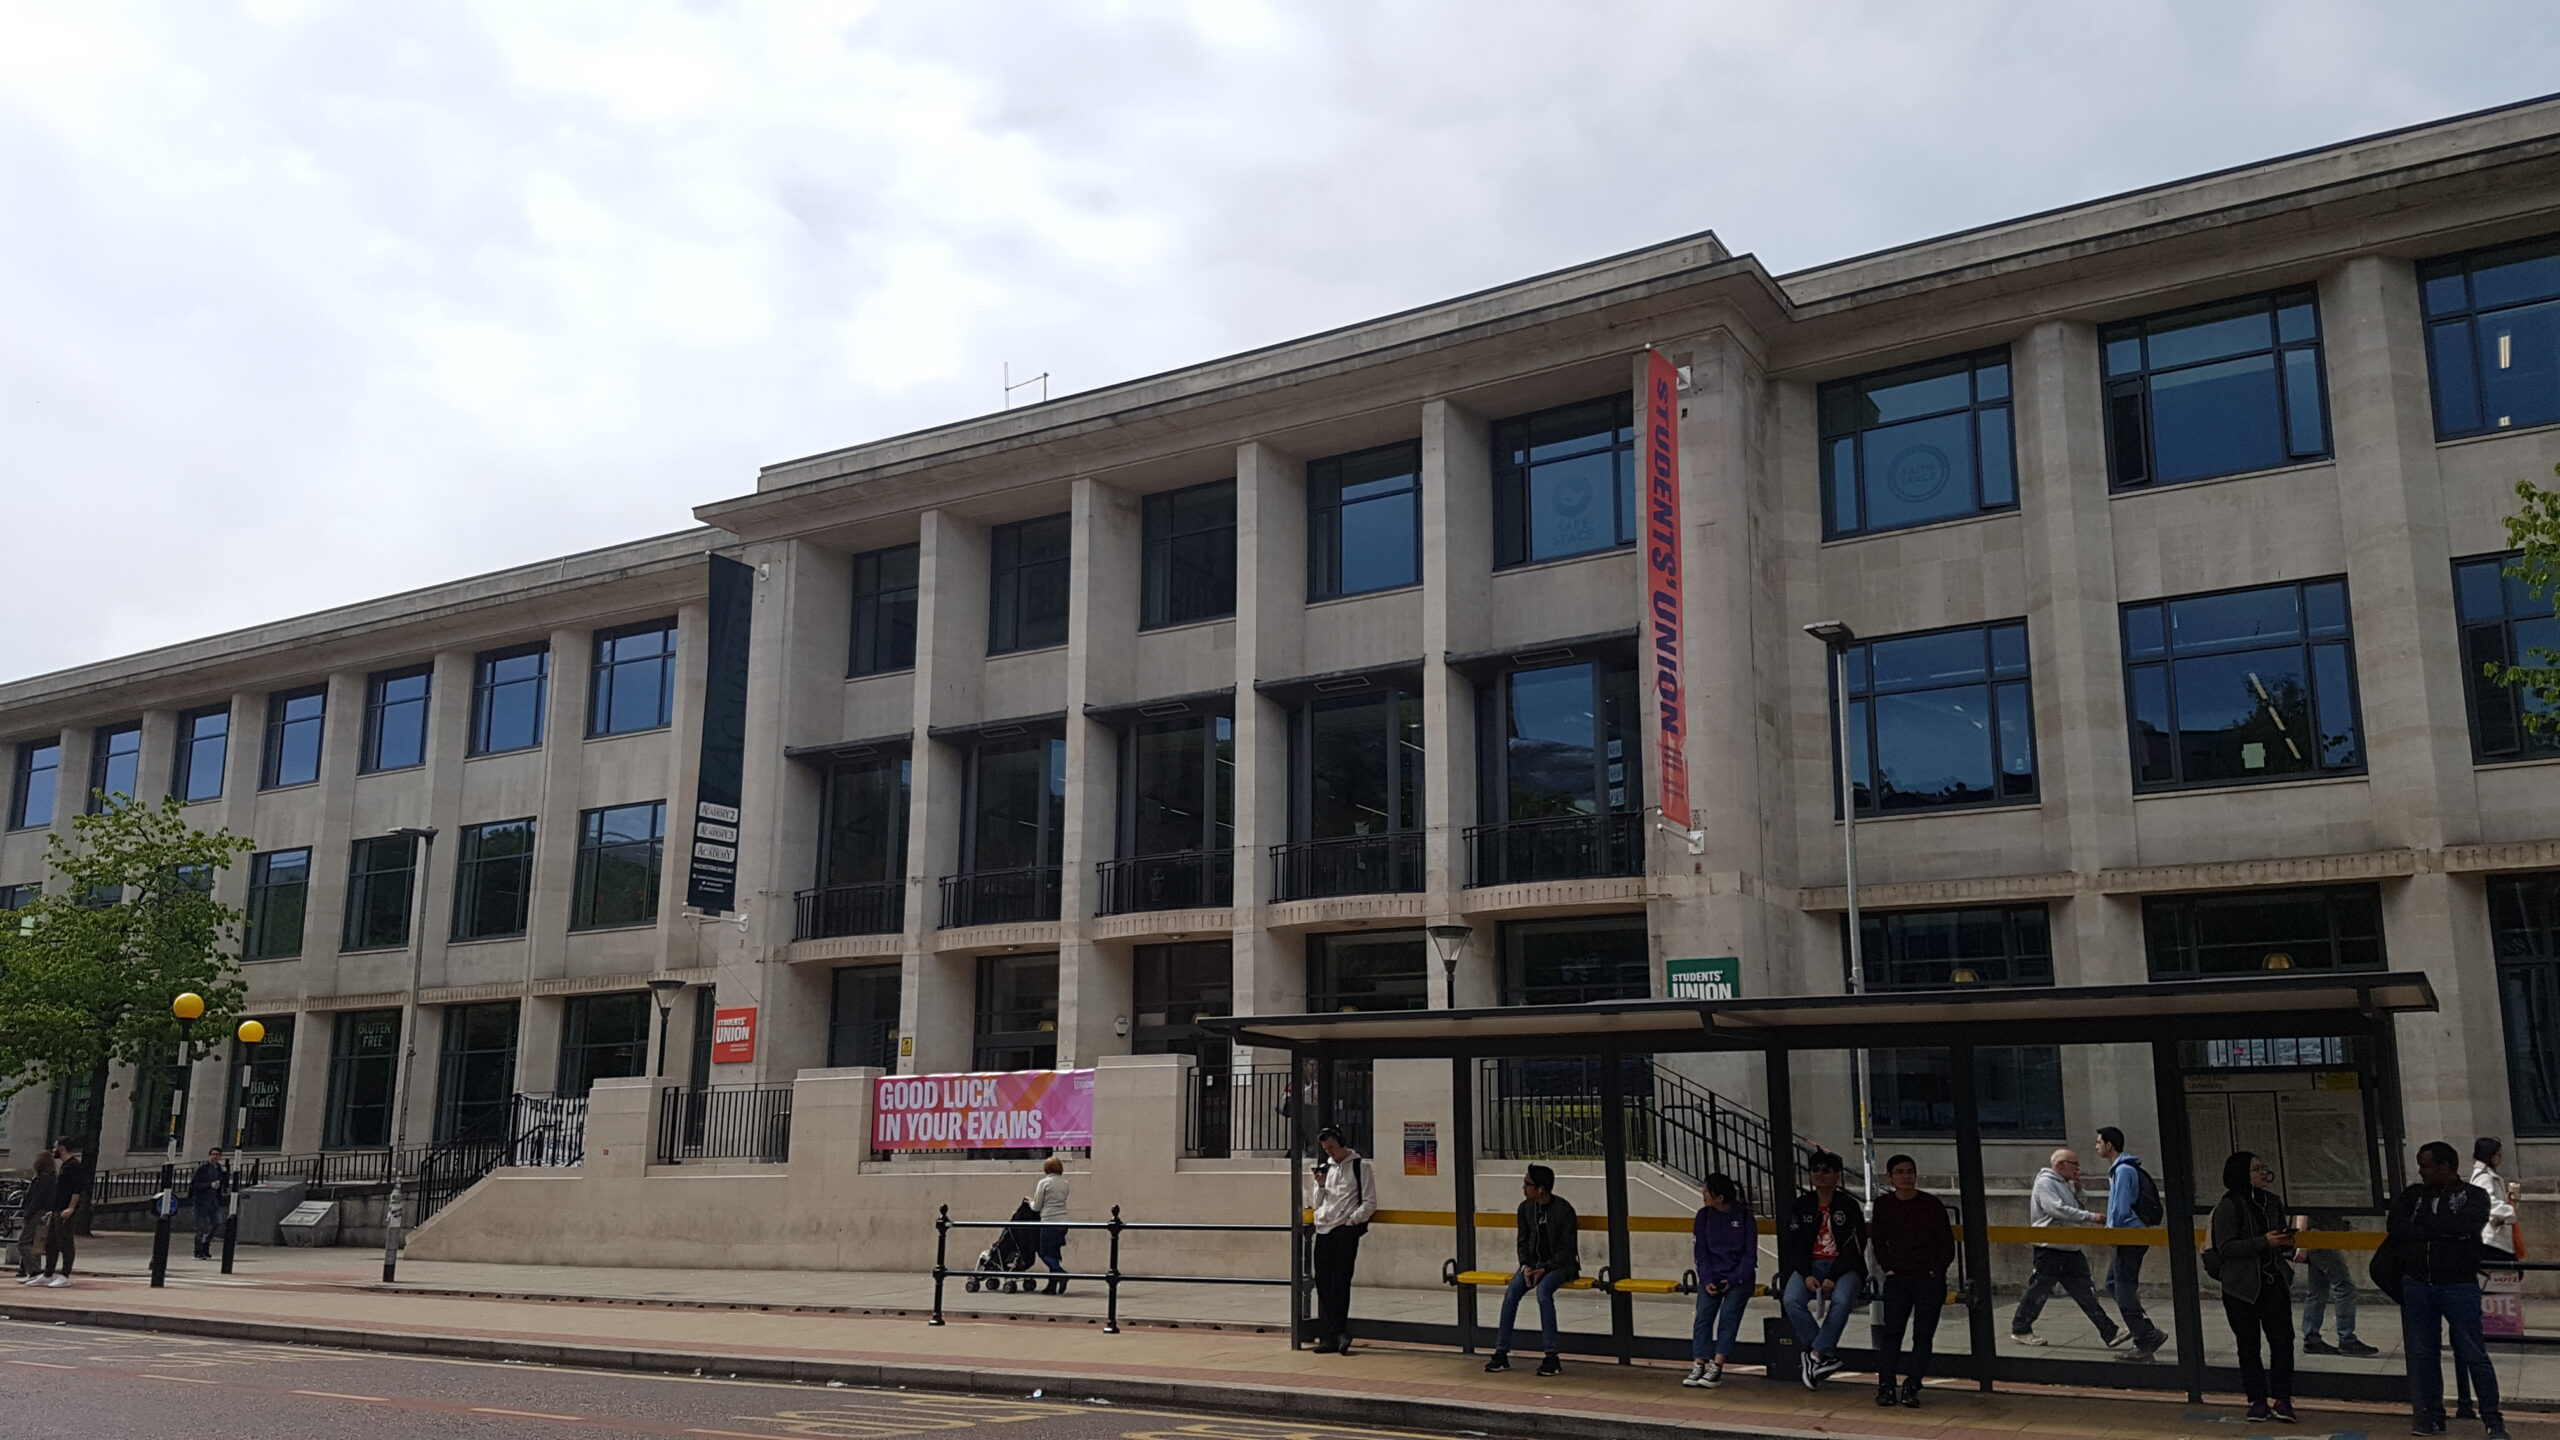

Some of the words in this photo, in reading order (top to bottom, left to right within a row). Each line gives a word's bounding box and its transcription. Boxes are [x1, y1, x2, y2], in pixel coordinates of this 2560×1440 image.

[1652, 377, 1678, 589] STUDENTS'
[1653, 591, 1680, 736] UNION
[1672, 970, 1723, 982] STUDENTS'
[1672, 983, 1732, 1000] UNION
[358, 1022, 392, 1035] GLUTEN
[716, 1027, 750, 1044] UNION
[262, 1032, 285, 1044] EGAN
[361, 1035, 384, 1048] FREE
[879, 1080, 939, 1111] GOOD
[943, 1079, 998, 1109] LUCK
[878, 1113, 902, 1142] IN
[906, 1112, 963, 1141] YOUR
[967, 1110, 1043, 1140] EXAMS
[2481, 1296, 2517, 1317] OTE
